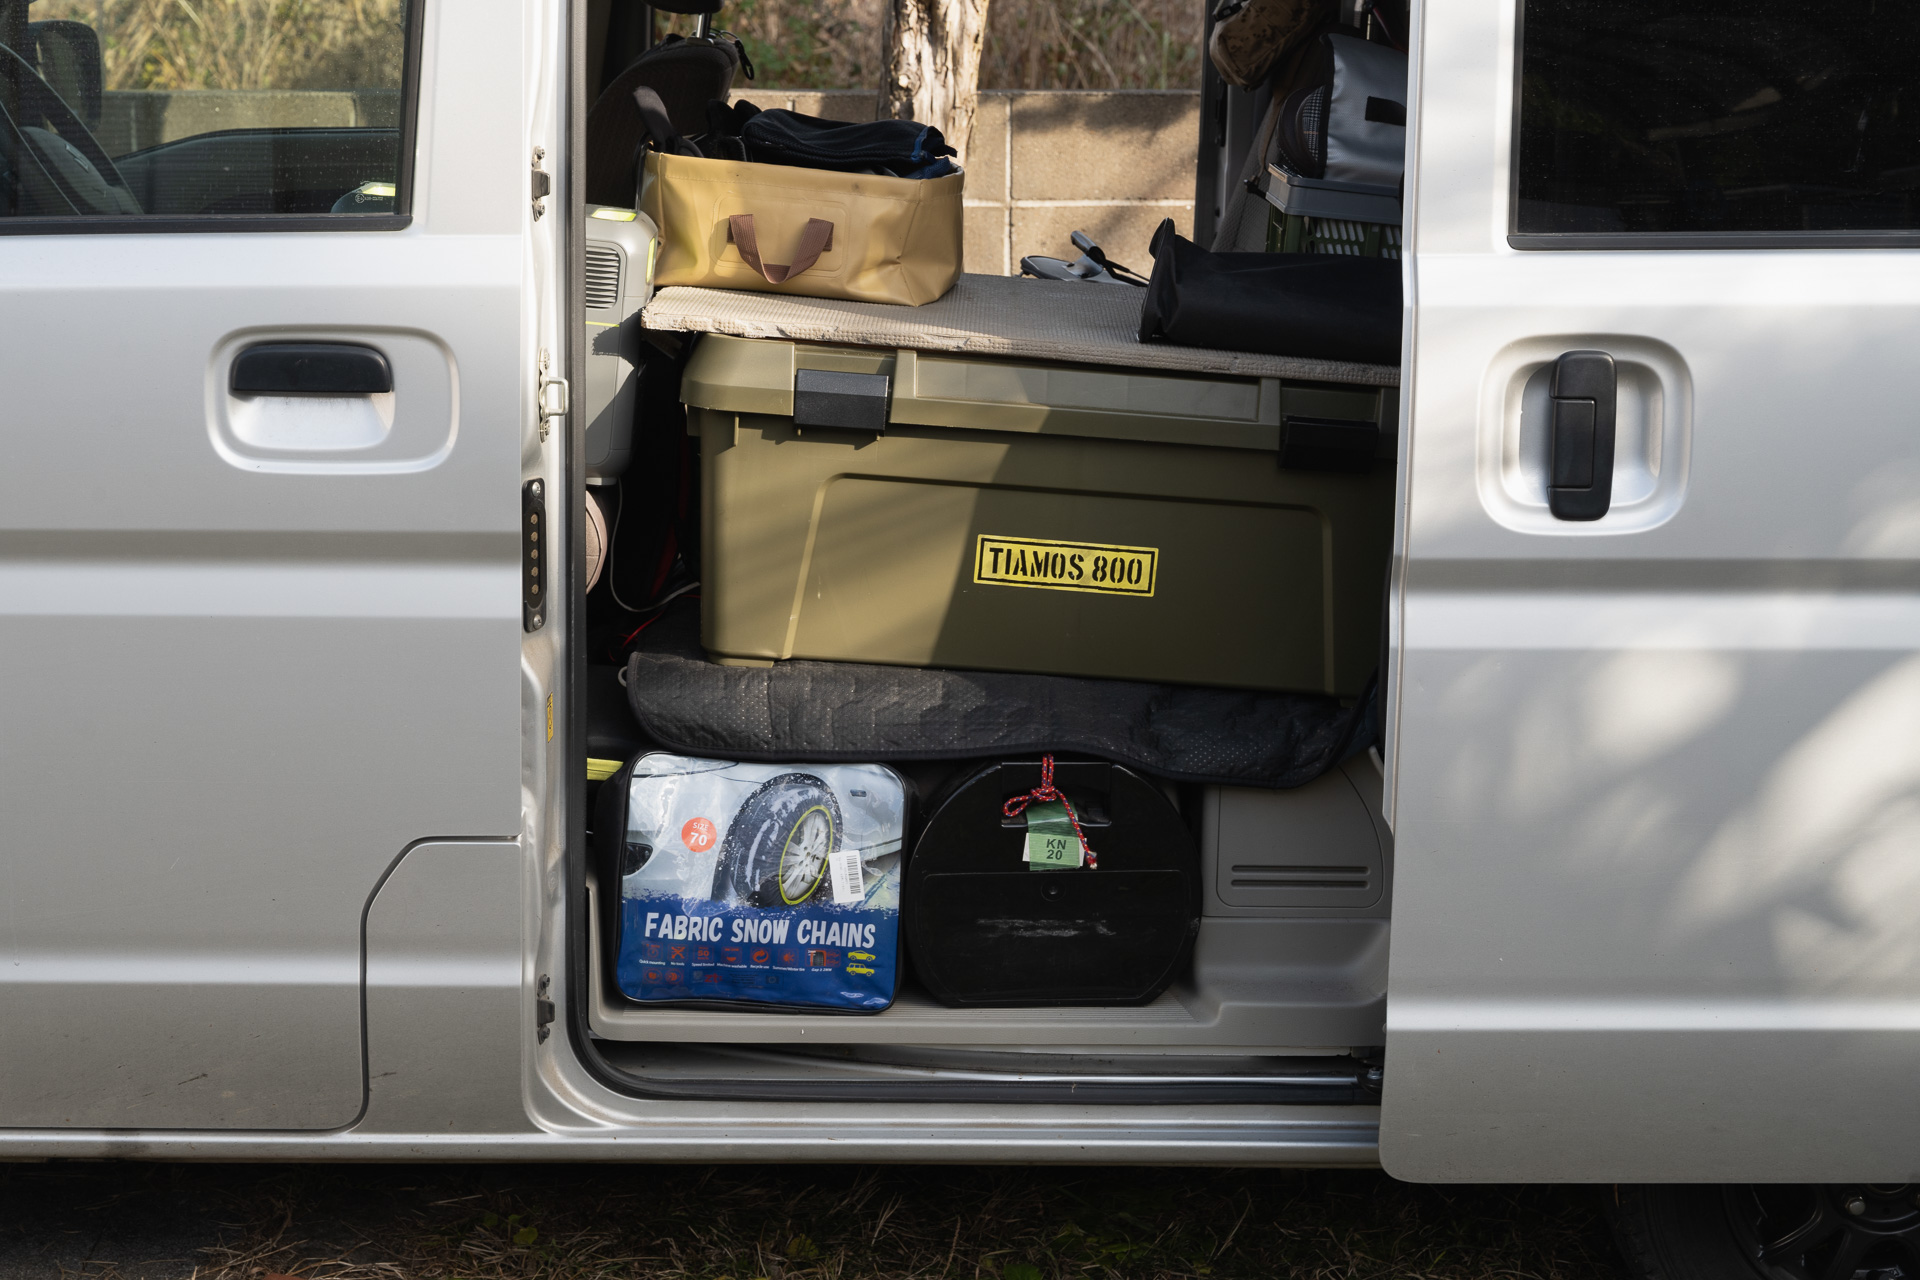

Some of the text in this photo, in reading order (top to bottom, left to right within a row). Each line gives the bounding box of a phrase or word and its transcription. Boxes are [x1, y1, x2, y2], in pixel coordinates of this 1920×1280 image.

[989, 547, 1143, 585] TIAMOS 800
[692, 822, 709, 831] SIZE
[690, 832, 708, 846] 70
[1046, 838, 1067, 850] KN
[1046, 849, 1063, 861] 20
[644, 912, 876, 949] FABRIC SNOW CHAINS
